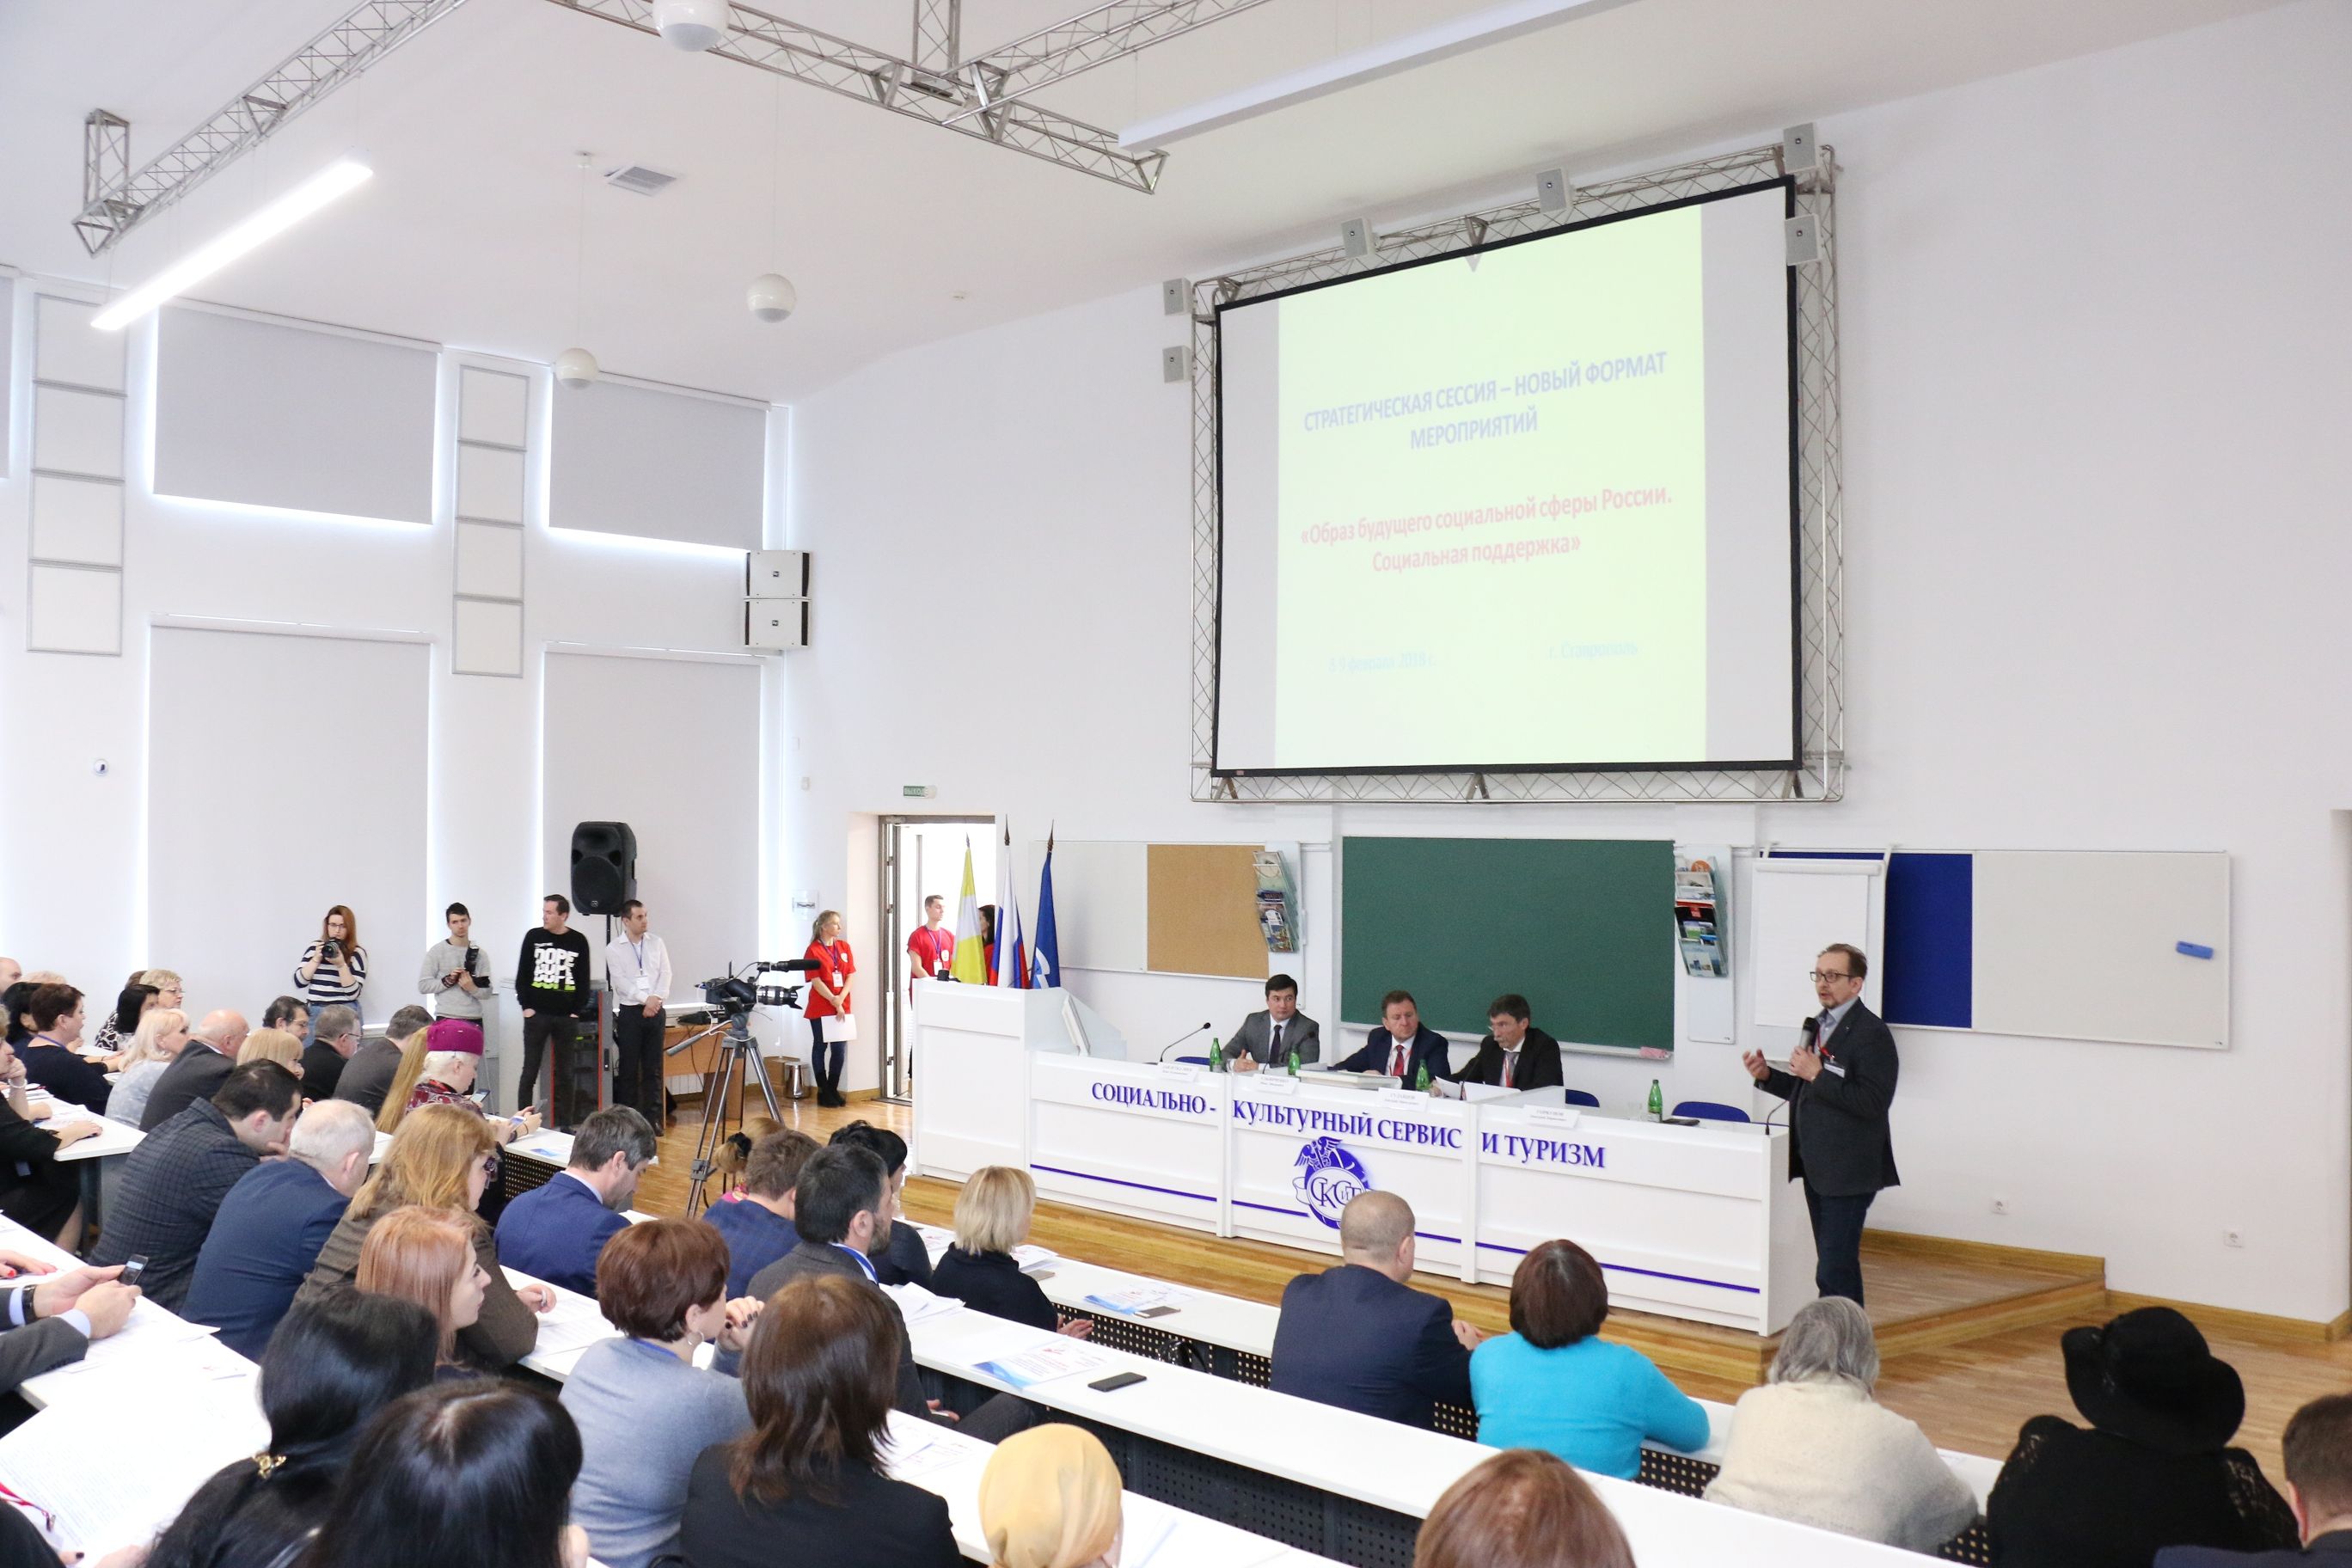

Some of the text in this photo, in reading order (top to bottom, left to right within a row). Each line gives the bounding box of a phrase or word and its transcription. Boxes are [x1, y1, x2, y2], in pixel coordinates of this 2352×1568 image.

[1304, 391, 1432, 432] СТРАТЕГИЧЕСКАЯ
[1436, 380, 1497, 409] СЕССИЯ
[1515, 359, 1581, 396] НОВЫЙ
[1585, 352, 1667, 384] ФОРМАТ
[1411, 404, 1537, 449] МЕРОПРИЯТИЙ
[1301, 487, 1672, 546] «Образ будущего социальной сферы России.
[1373, 536, 1581, 573] Социальная поддержка»
[1092, 1081, 1204, 1114] СОЦИАЛЬНО
[1232, 1099, 1463, 1149] КУЛЬТУРНЫЙ СЕРВИС
[1482, 1131, 1607, 1171] И ТУРИЗМ
